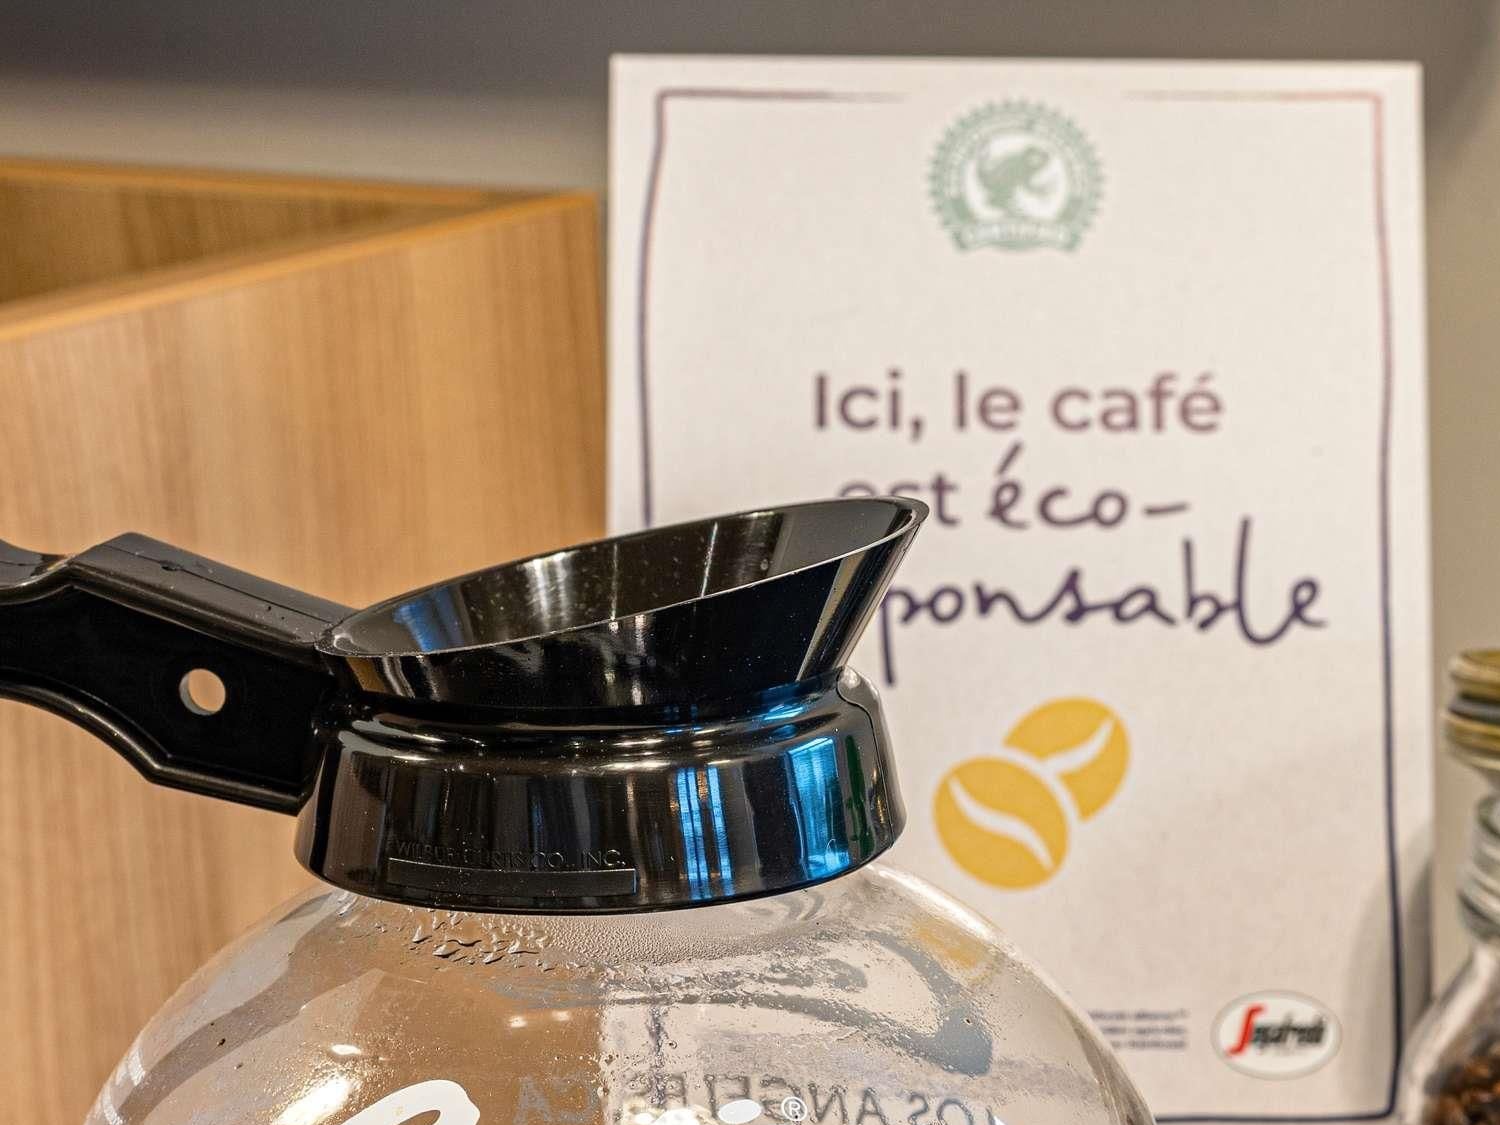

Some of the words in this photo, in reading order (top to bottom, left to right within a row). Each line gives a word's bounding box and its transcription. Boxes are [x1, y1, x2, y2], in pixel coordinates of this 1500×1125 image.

[814, 368, 926, 441] Ici,
[954, 370, 1022, 433] le
[1048, 371, 1223, 433] café
[880, 516, 1328, 686] ponsable
